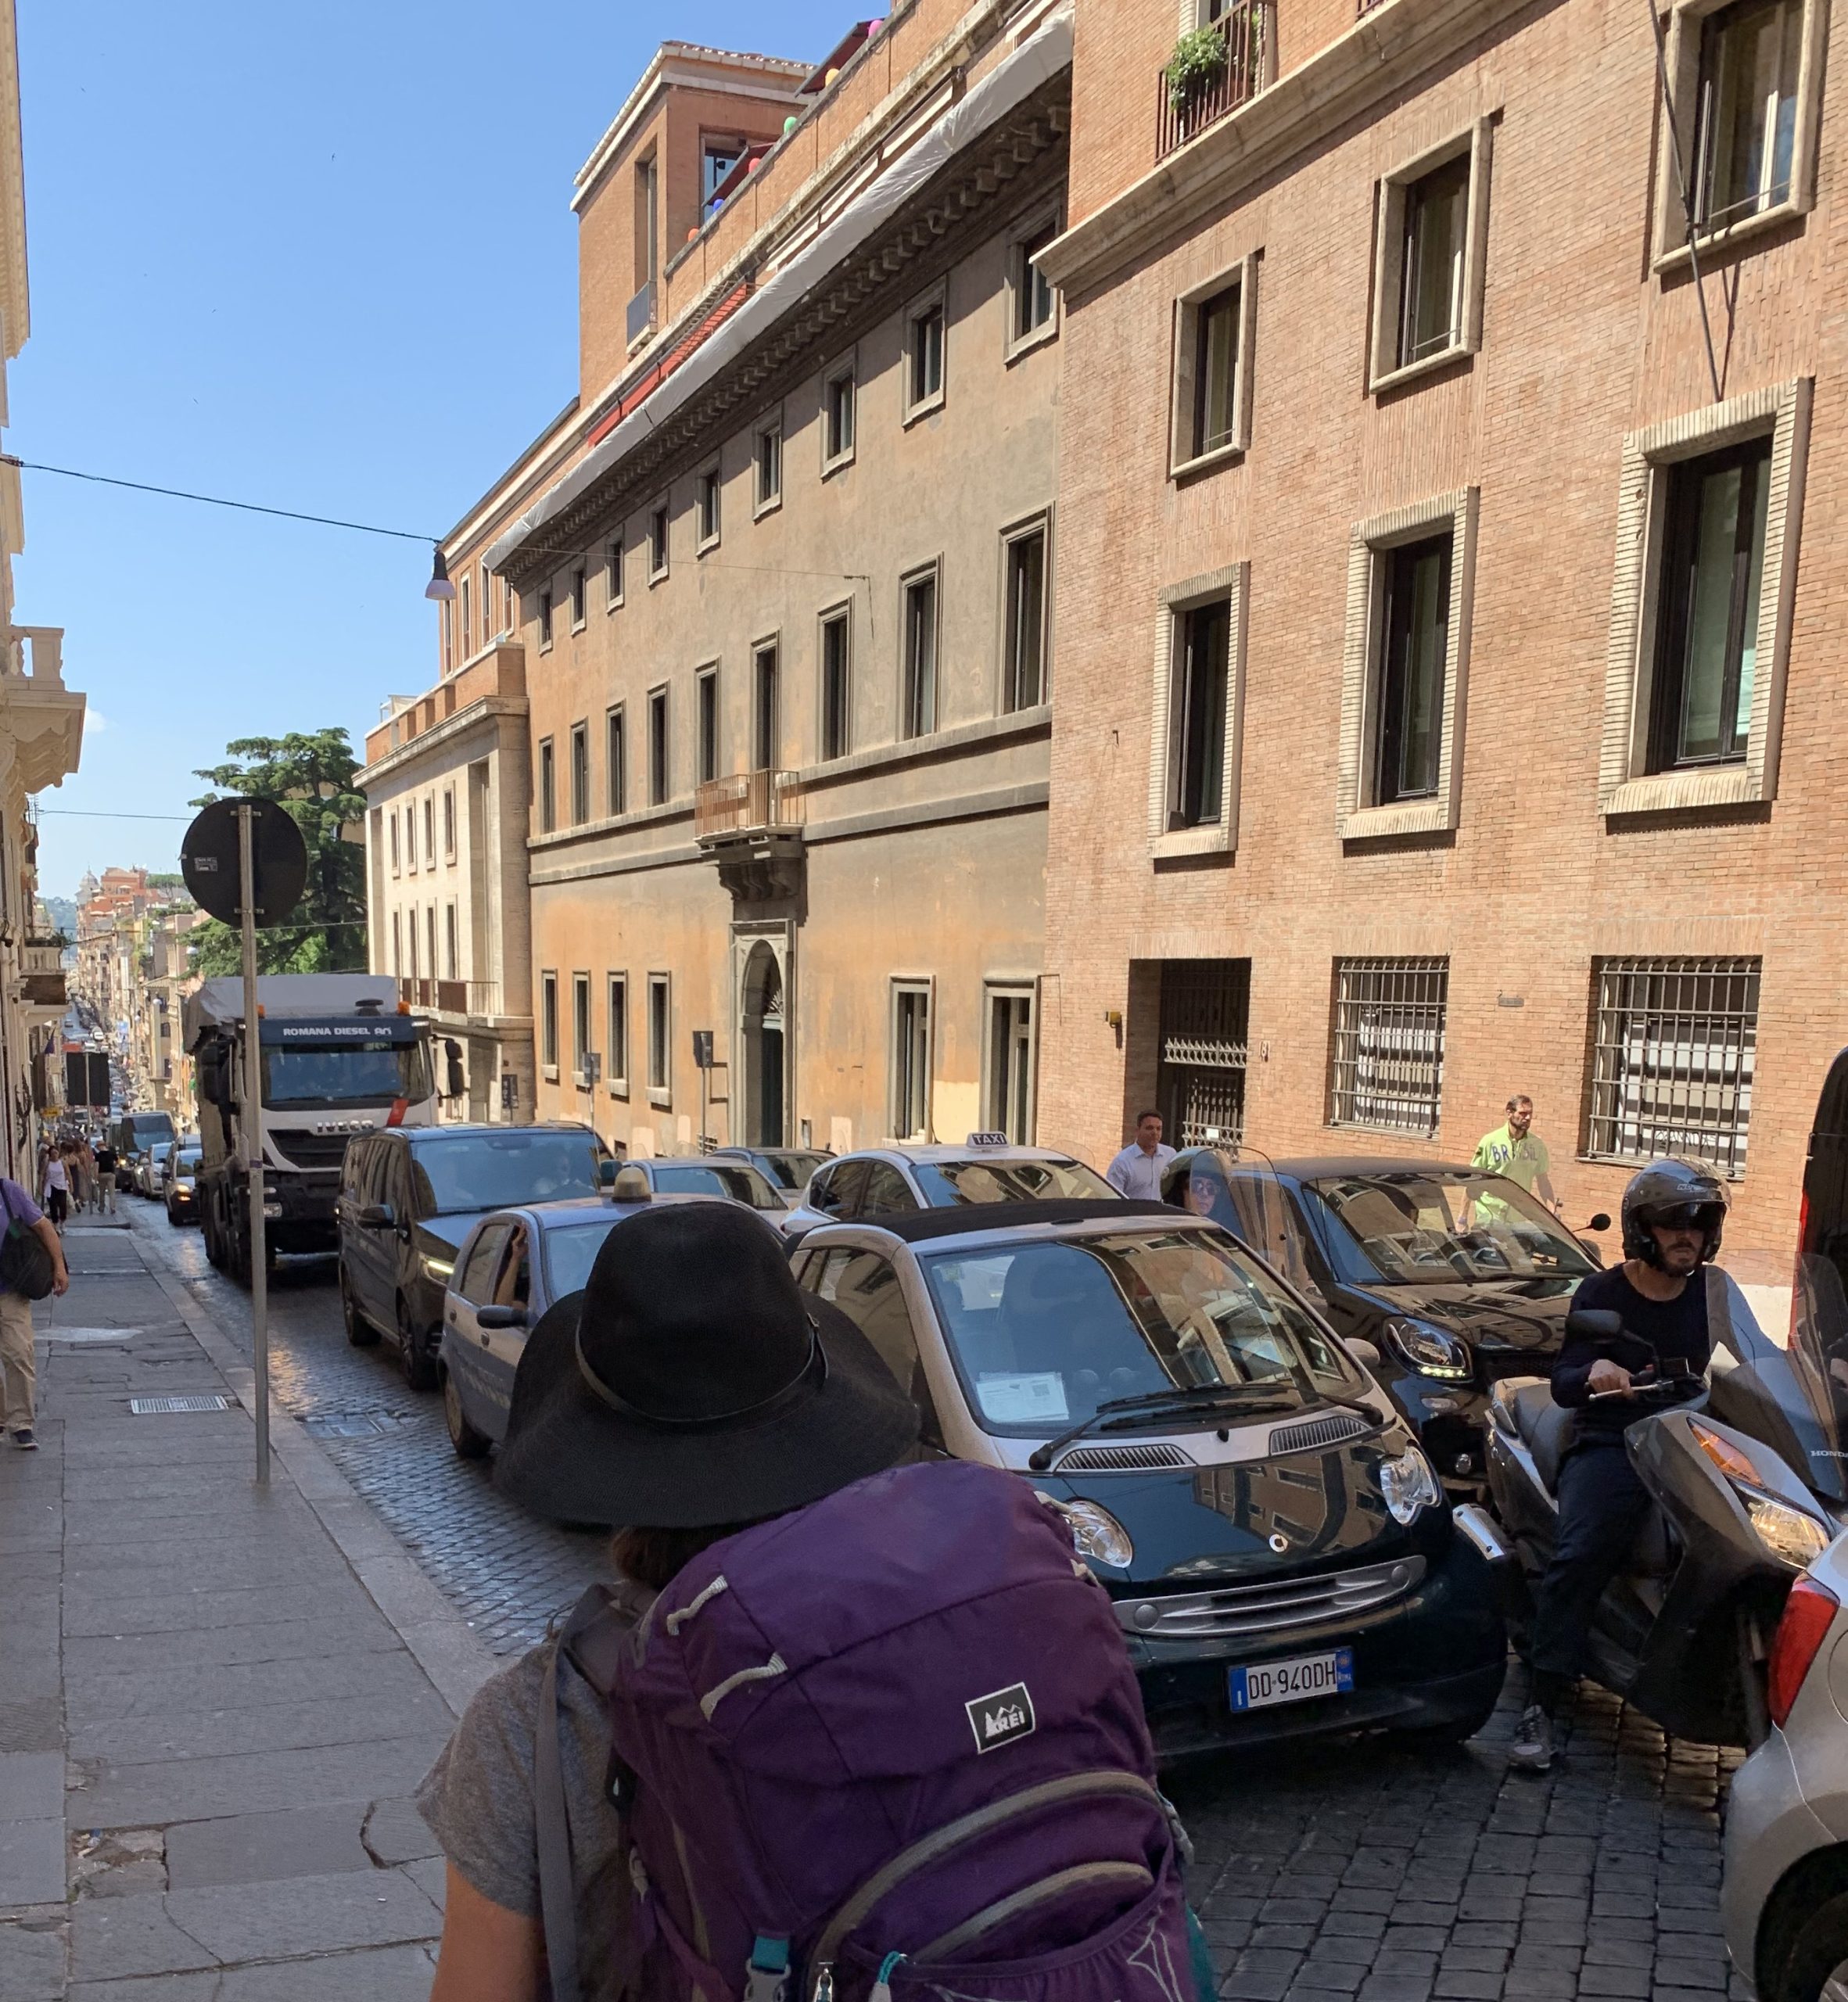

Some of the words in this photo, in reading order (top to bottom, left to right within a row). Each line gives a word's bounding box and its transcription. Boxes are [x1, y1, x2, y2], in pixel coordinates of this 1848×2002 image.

[283, 1027, 332, 1036] ROMANA
[334, 1027, 371, 1035] DIESEL
[317, 1120, 373, 1133] IVECO
[974, 1134, 1006, 1144] TAXI
[996, 1710, 1025, 1734] REI
